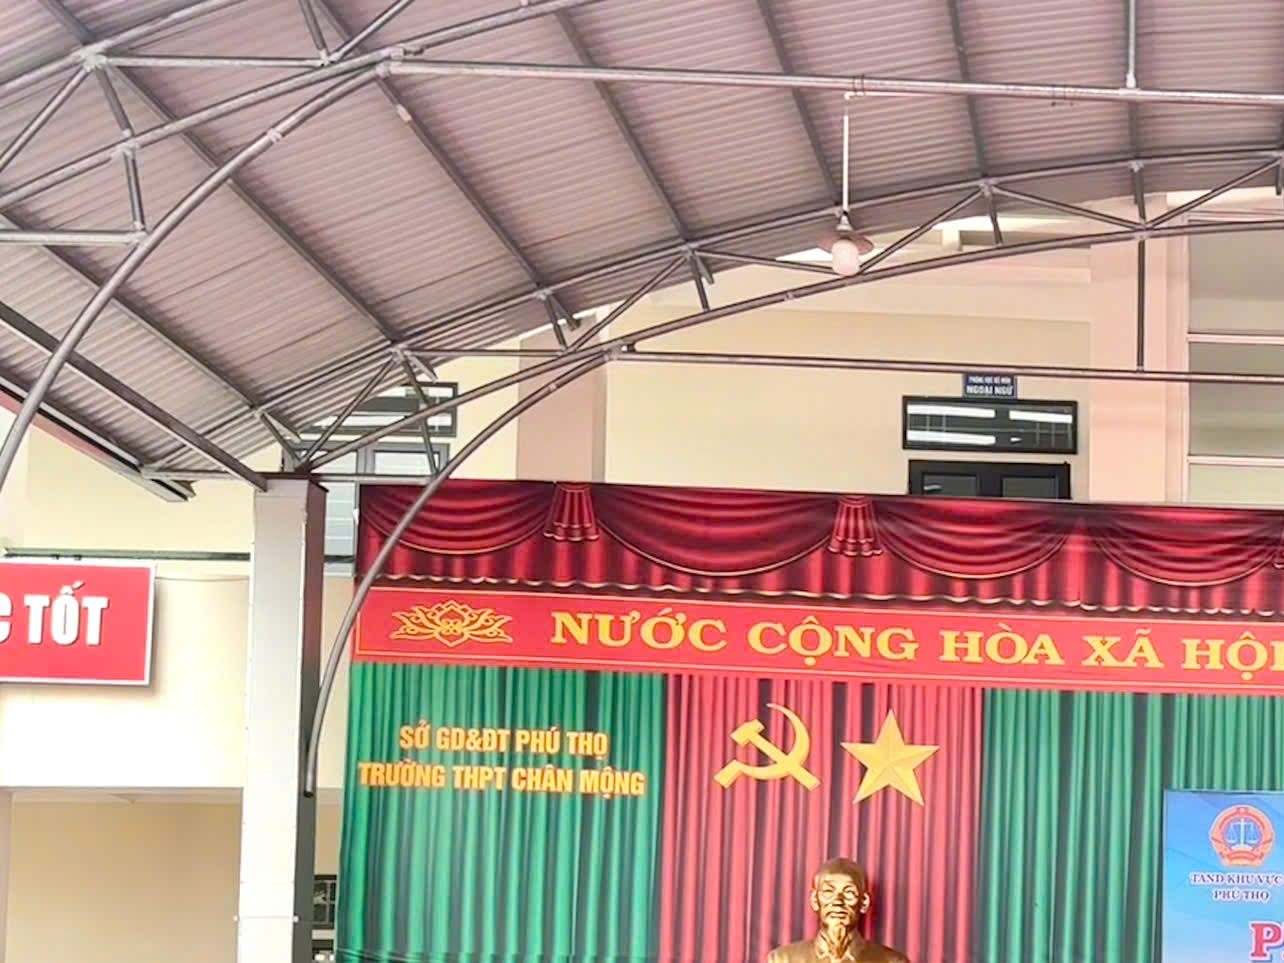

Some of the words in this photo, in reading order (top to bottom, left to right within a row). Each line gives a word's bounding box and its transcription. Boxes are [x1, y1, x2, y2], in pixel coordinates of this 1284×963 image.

[23, 580, 109, 646] TỐT
[550, 607, 728, 651] NƯỚC
[747, 615, 919, 666] CỘNG
[939, 622, 1065, 666] HÒA
[1081, 628, 1164, 668] XÃ
[400, 718, 431, 750] SỞ
[435, 726, 511, 752] GD&ĐT
[515, 725, 561, 754] PHÚ
[566, 731, 610, 760] THỌ
[358, 758, 446, 788] TRƯỜNG
[452, 765, 507, 791] THPT
[511, 763, 574, 793] CHÂN
[578, 765, 647, 799] MỘNG
